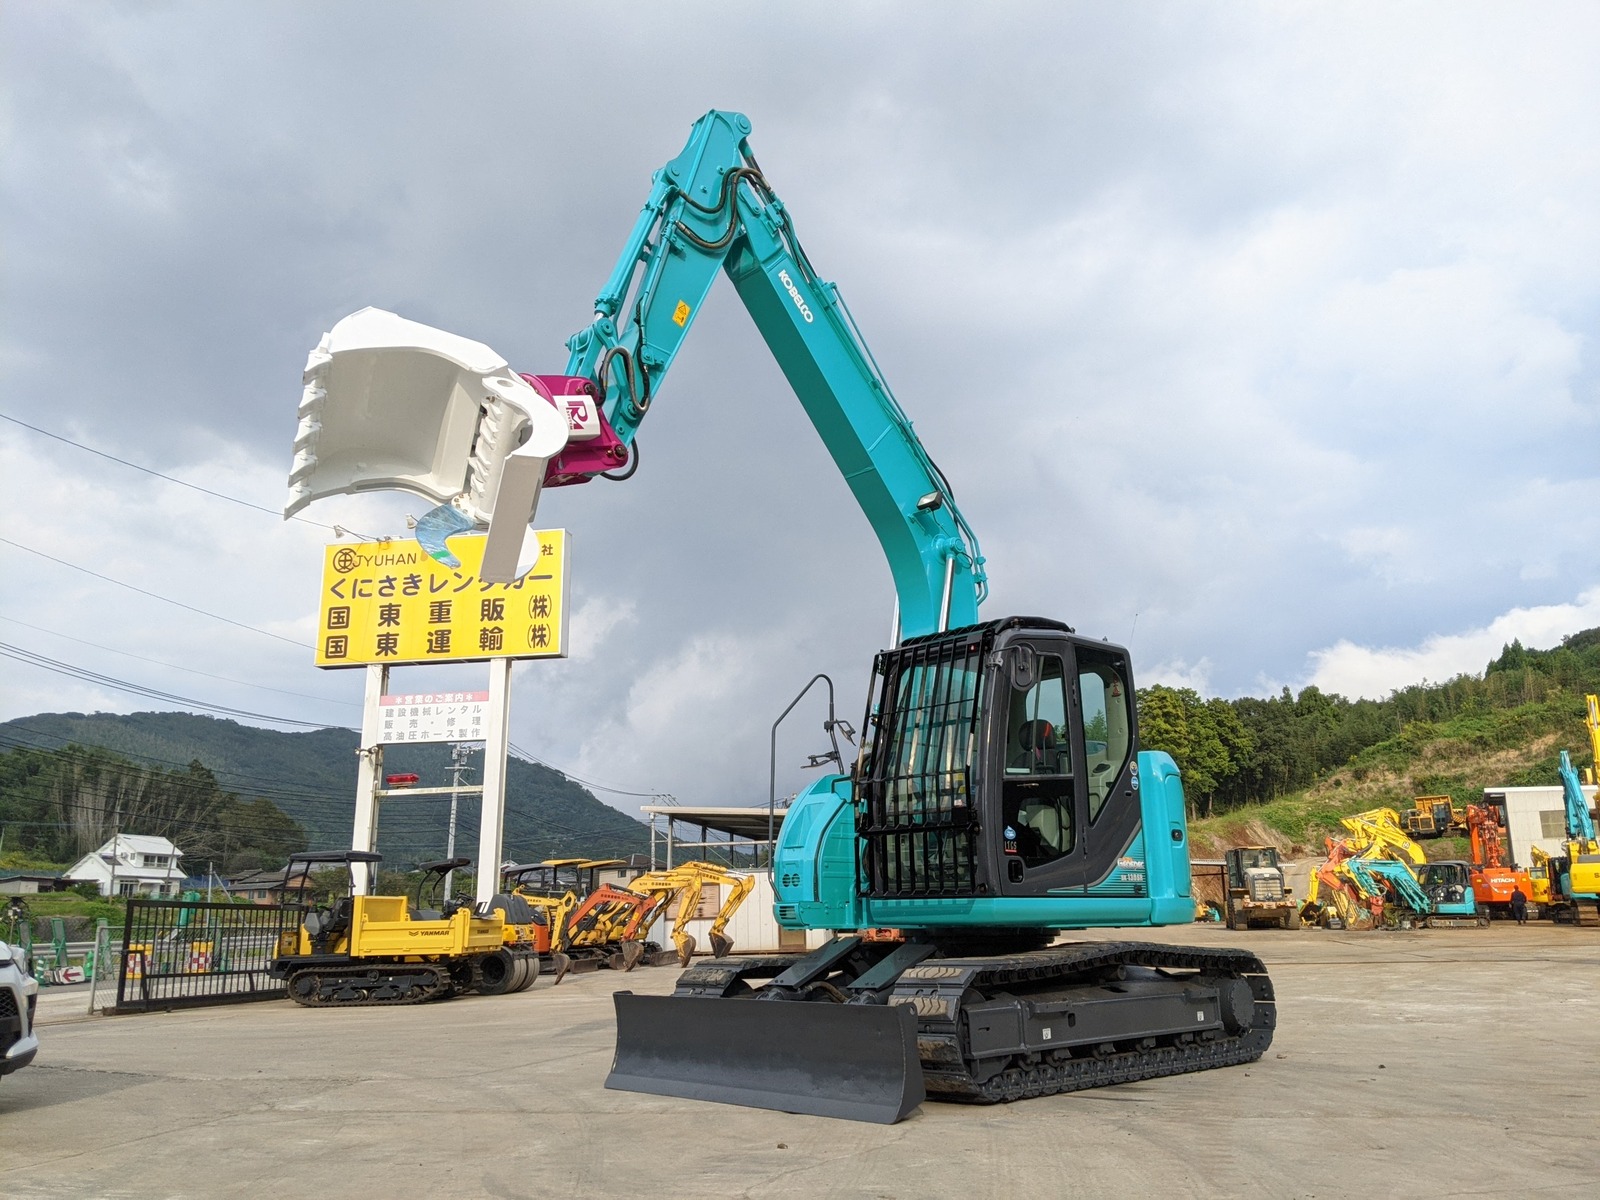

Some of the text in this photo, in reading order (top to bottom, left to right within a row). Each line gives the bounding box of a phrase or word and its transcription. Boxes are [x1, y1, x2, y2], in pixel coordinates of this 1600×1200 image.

[778, 269, 813, 323] KOBELCO
[541, 543, 554, 556] 社
[352, 552, 417, 568] JYUHAN
[385, 705, 482, 718] 建設機械レンタル
[383, 728, 481, 741] 高油圧ホース製作
